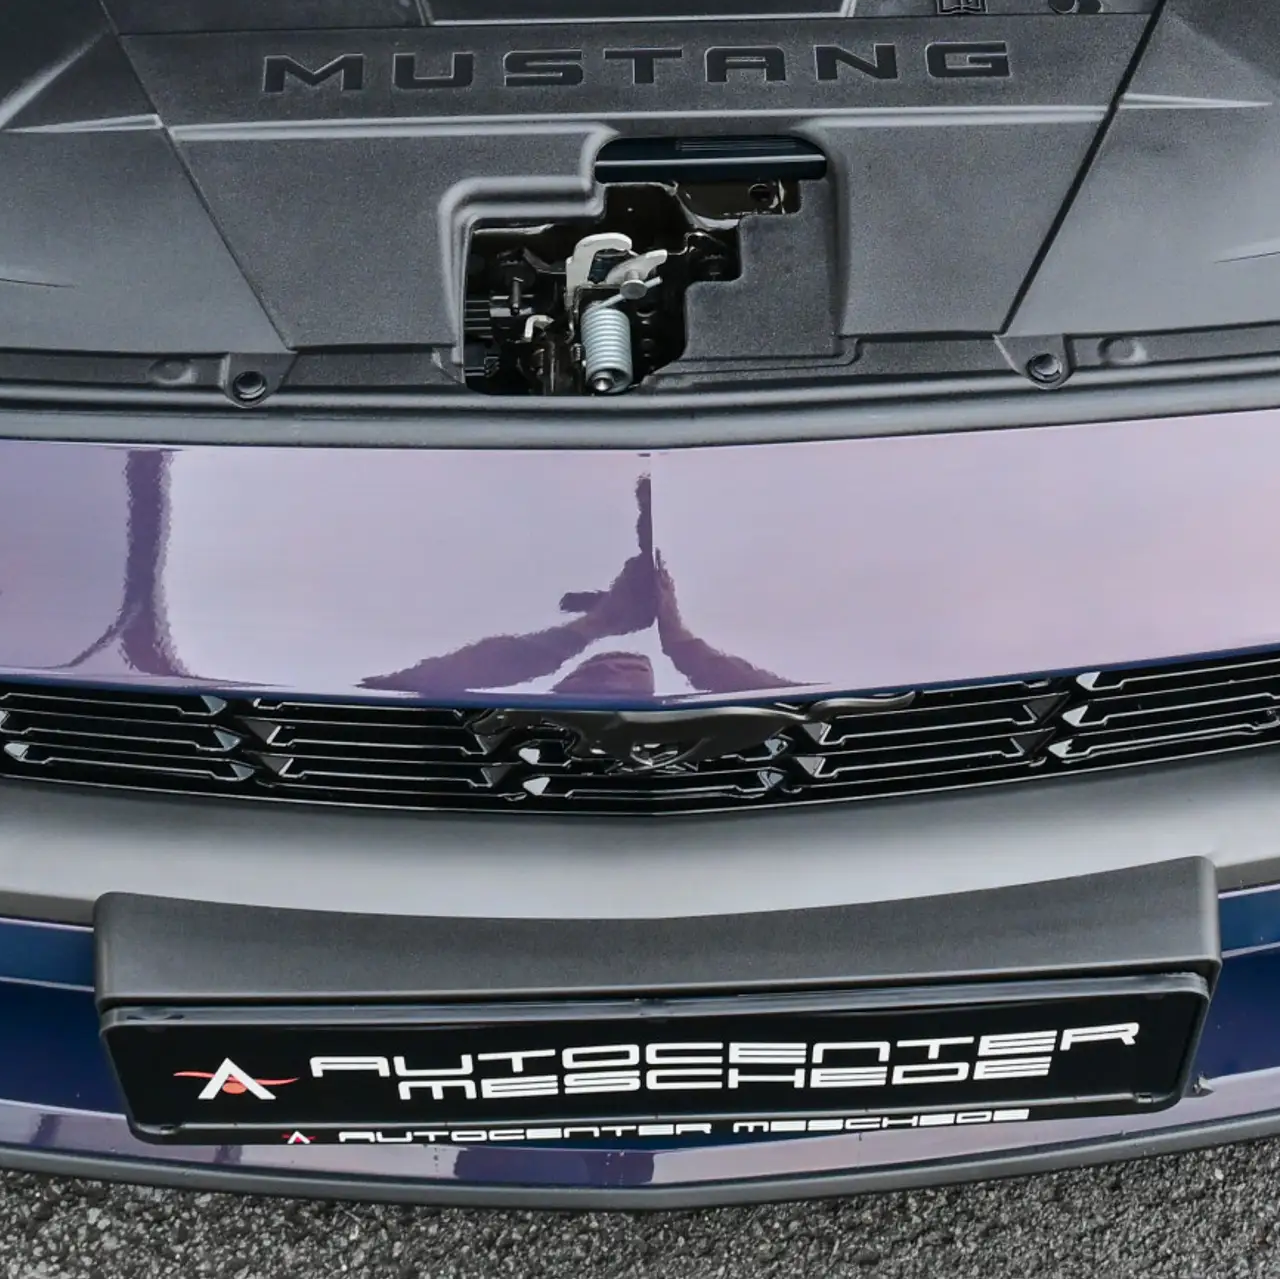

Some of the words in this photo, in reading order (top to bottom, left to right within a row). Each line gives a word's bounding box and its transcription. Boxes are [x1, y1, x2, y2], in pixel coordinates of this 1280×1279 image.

[262, 40, 1011, 93] MUSTANG
[309, 1022, 1140, 1078] AUTOCENTER
[398, 1055, 1052, 1100] MESCHEDE
[338, 1122, 712, 1143] AUTOCENTER
[732, 1108, 1030, 1133] MESCHEDE
